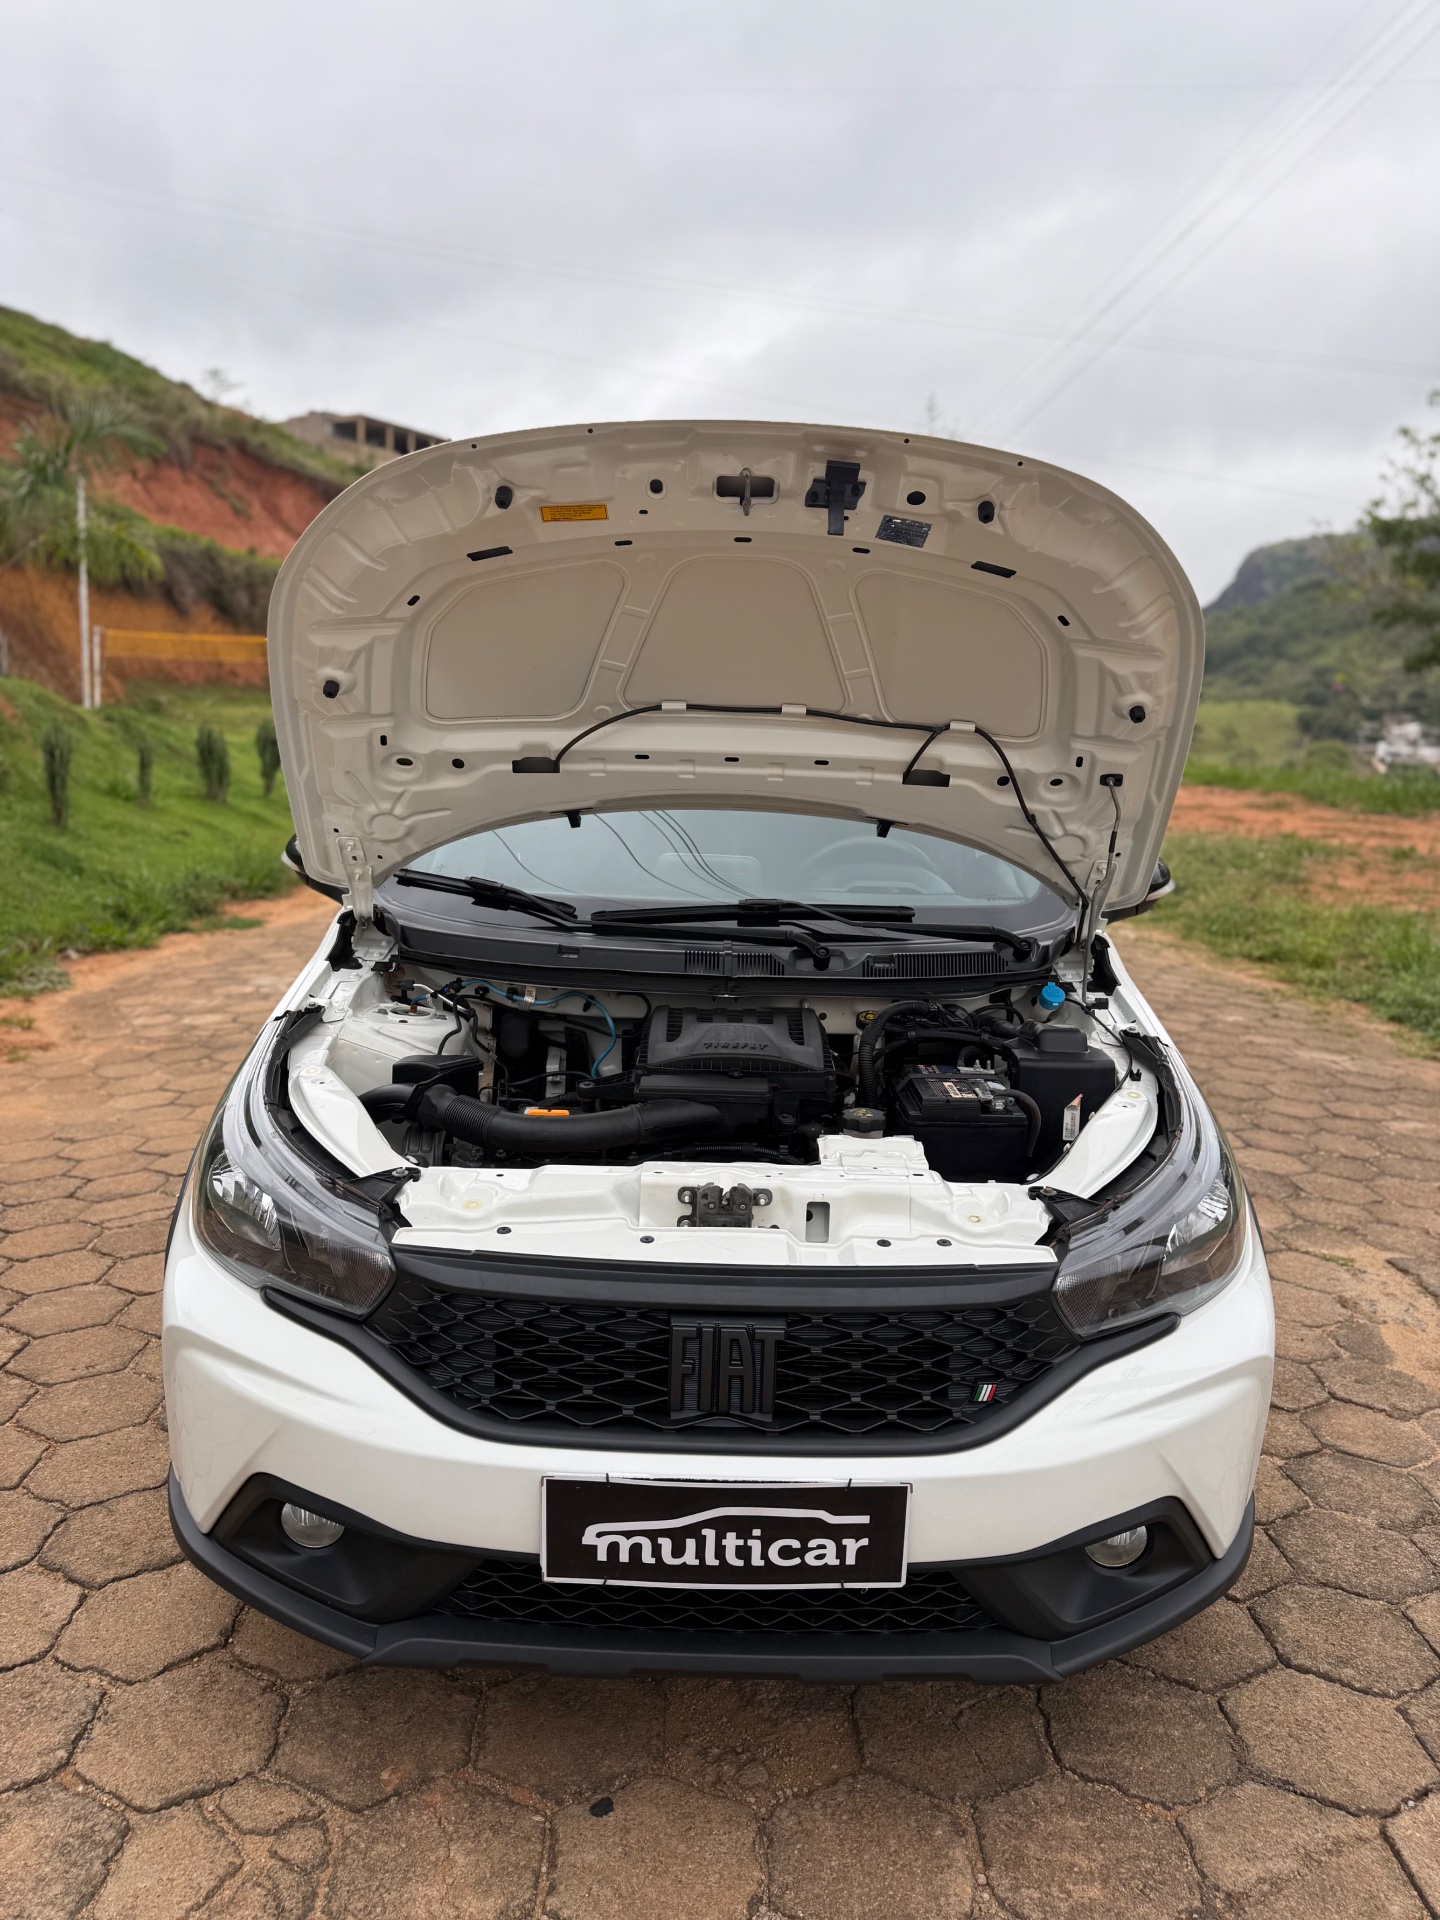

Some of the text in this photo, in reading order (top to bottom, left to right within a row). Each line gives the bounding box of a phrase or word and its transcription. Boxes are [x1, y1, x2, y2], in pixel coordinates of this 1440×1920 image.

[703, 1042, 769, 1051] FIREFLY
[671, 1325, 786, 1414] FIAT
[592, 1527, 868, 1567] multicar
